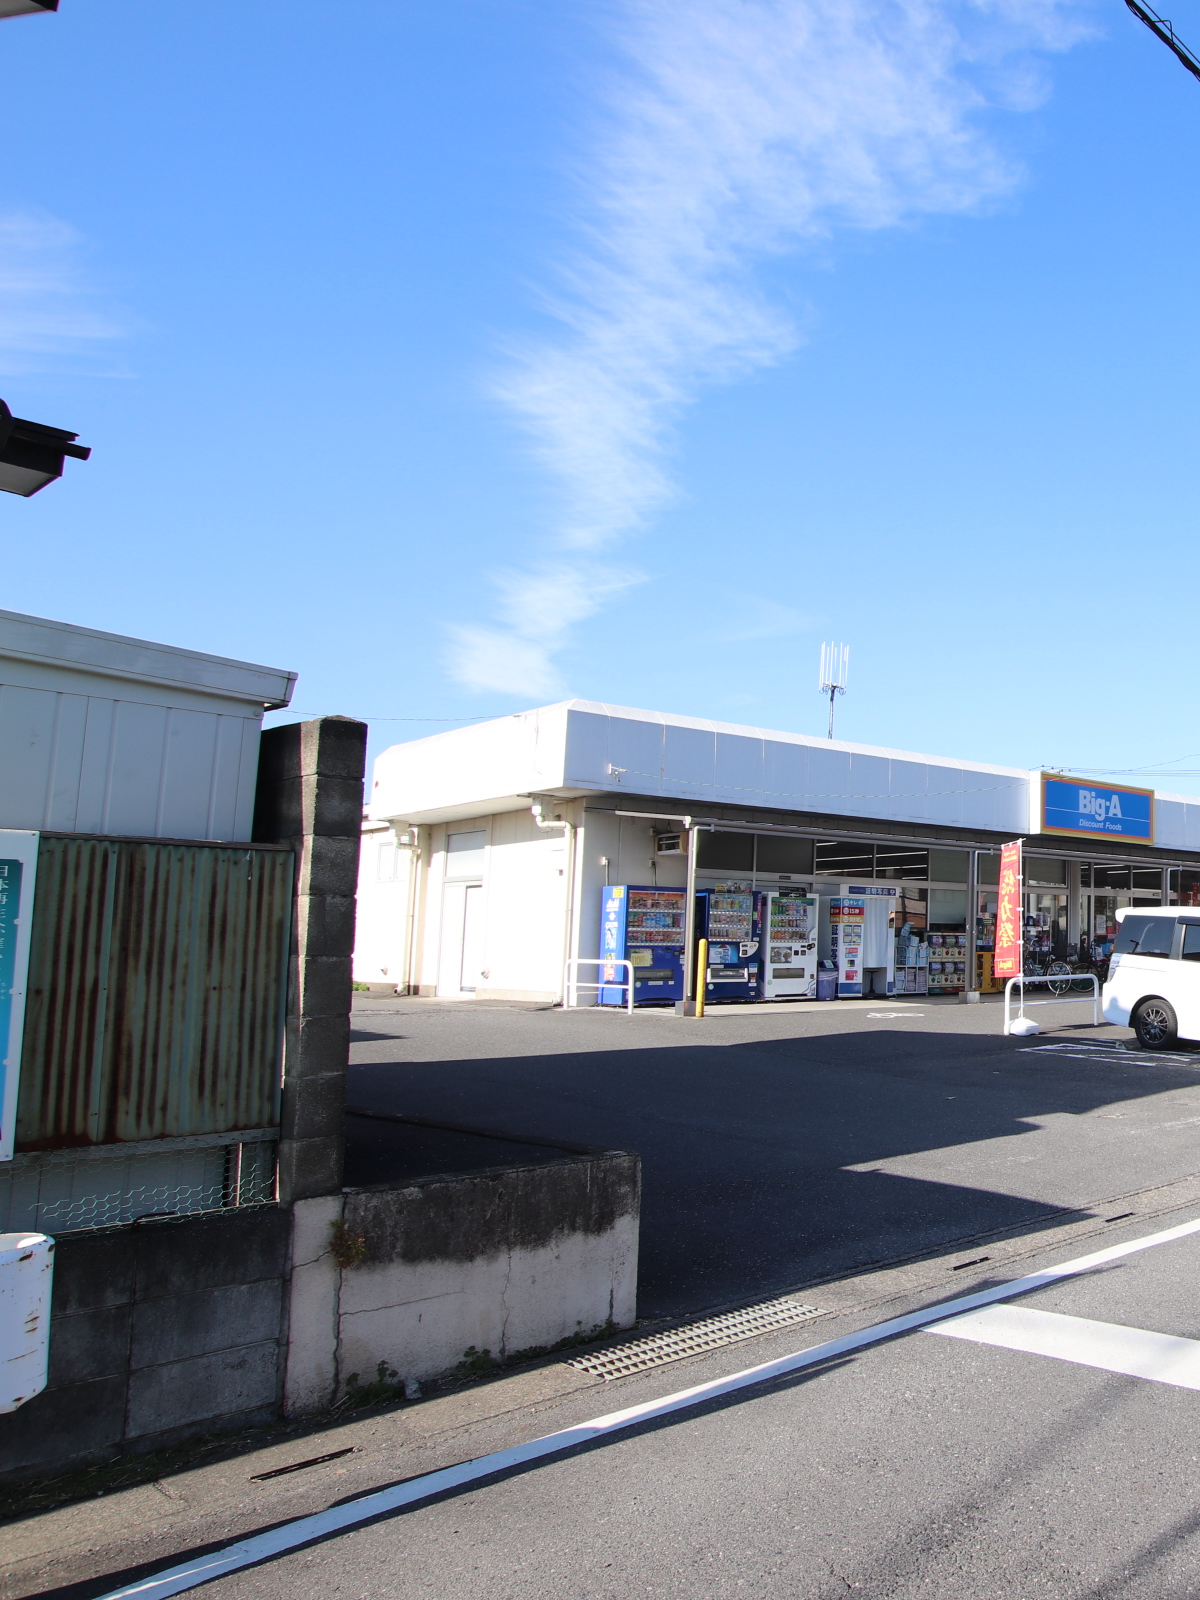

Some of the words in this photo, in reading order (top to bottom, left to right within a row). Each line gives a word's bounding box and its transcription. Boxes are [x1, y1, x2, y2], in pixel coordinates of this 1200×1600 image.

[1079, 789, 1122, 821] Big-A
[1079, 819, 1104, 829] Discount
[1105, 822, 1122, 831] Foods
